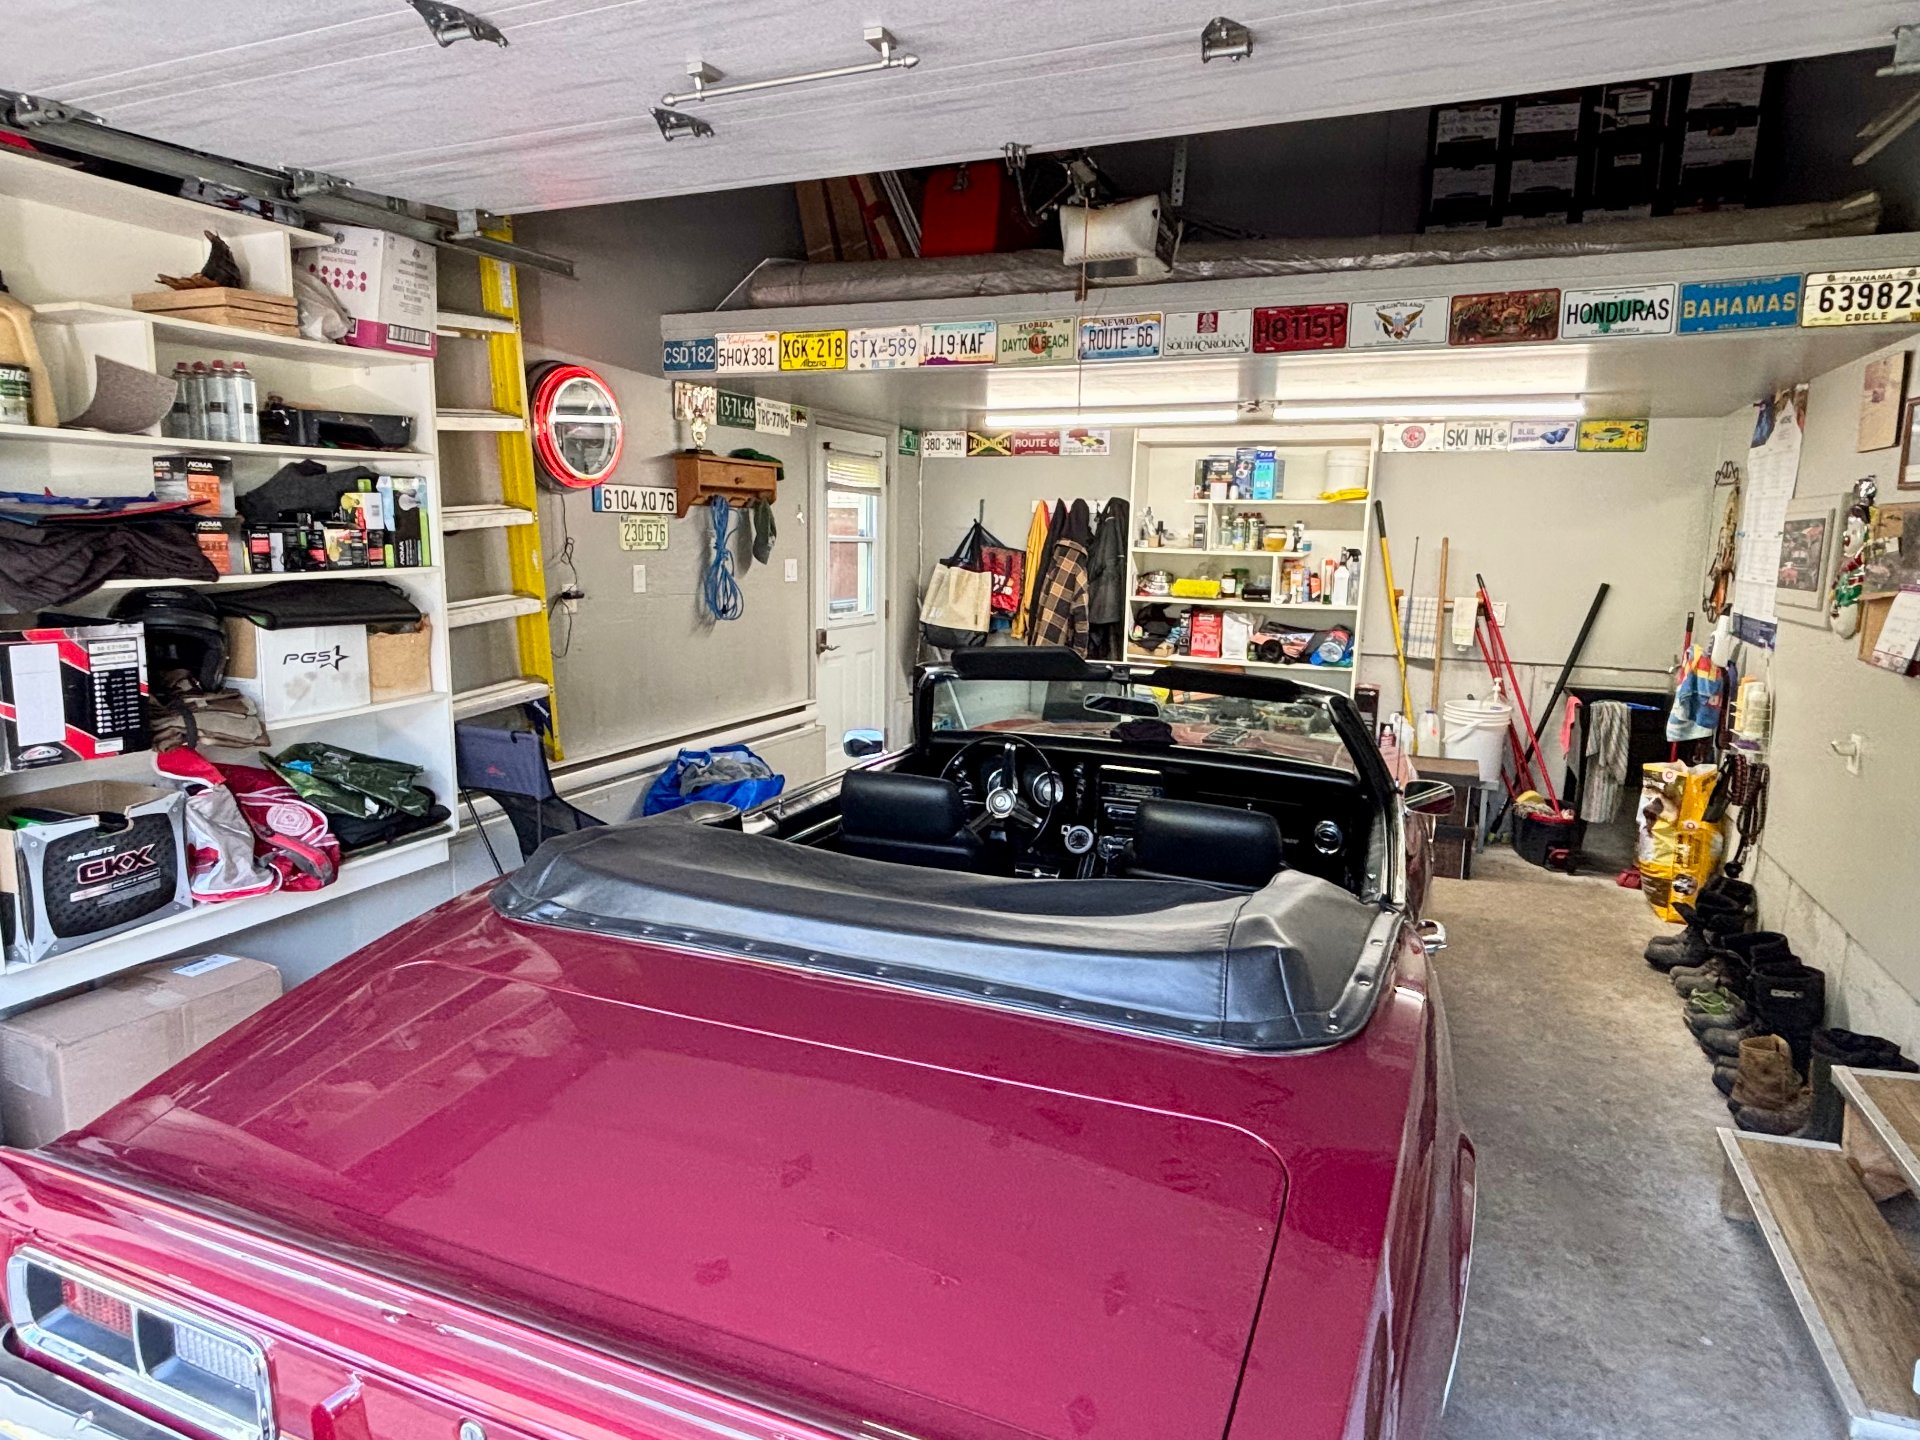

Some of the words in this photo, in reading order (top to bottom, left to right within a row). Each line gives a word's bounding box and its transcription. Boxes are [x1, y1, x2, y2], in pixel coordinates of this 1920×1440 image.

[1850, 273, 1893, 282] PANAMA
[1567, 298, 1669, 325] HONDURAS
[1683, 292, 1796, 319] BAHAMAS
[1019, 321, 1053, 331] FLORIDA
[1101, 317, 1140, 327] NEVADA
[1002, 334, 1040, 352] DAYTONA
[1041, 334, 1069, 349] BEACH
[1015, 439, 1046, 448] ROUTE
[1049, 438, 1060, 447] 66
[1447, 429, 1468, 446] SKI
[1474, 428, 1493, 445] NH
[187, 461, 213, 469] NOMA
[604, 489, 637, 511] 6104
[641, 491, 656, 510] XQ
[659, 492, 675, 511] 76
[283, 651, 331, 665] PGS
[67, 844, 116, 862] HELMETS
[77, 843, 157, 884] CKX
